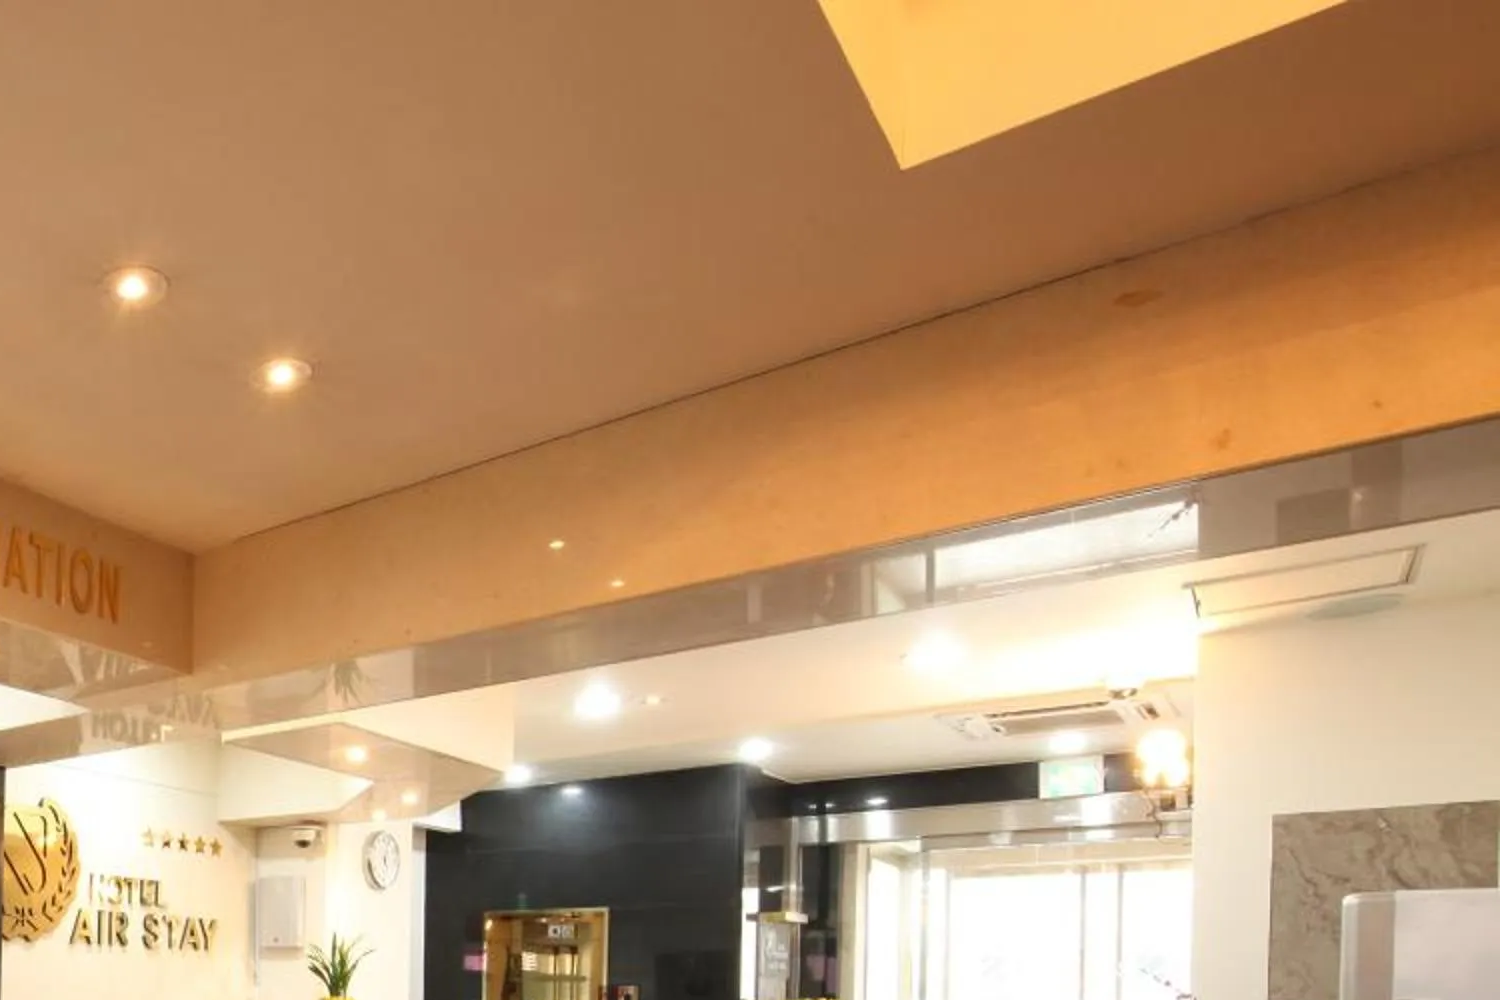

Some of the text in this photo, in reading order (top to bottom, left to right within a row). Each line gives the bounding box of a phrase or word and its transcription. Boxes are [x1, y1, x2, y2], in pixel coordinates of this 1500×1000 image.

[89, 872, 167, 909] HOTEL
[69, 908, 218, 952] AIR STAY
